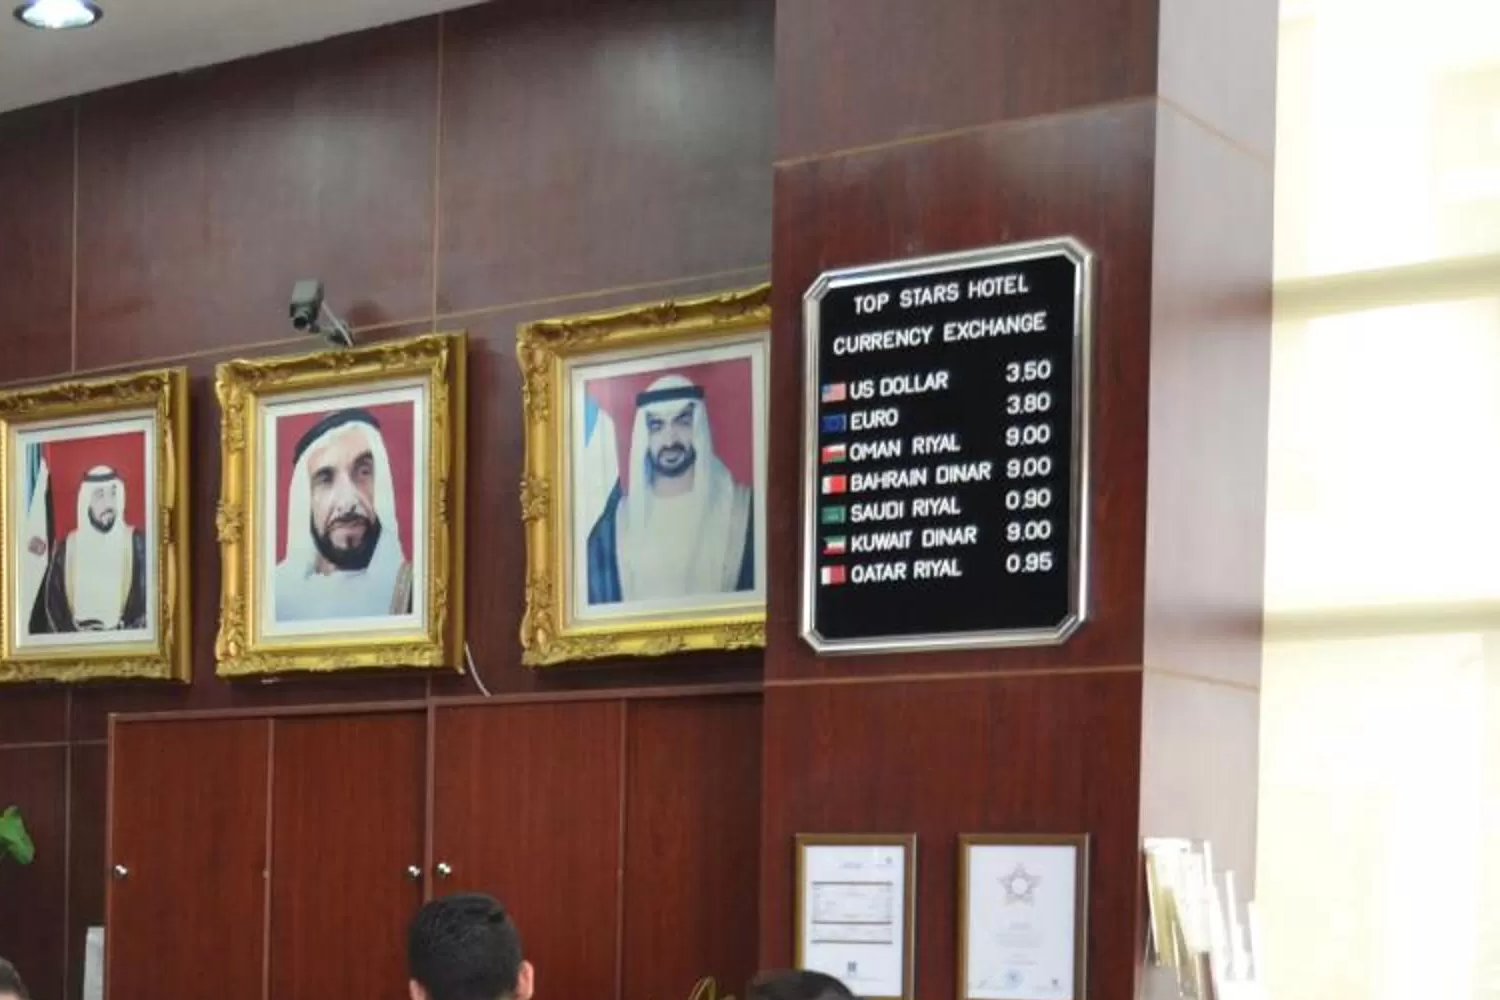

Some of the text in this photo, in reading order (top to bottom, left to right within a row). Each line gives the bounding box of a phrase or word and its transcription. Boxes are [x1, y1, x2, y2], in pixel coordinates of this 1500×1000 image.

[853, 273, 1029, 315] TOP STARS HOTEL
[832, 311, 1047, 356] CURRENCY EXCHANGE
[849, 359, 1052, 401] US DOLLAR 3.50
[850, 391, 1052, 432] EURO 3.80
[848, 423, 1051, 463] OMAN RIYAL 9.00
[849, 455, 1052, 494] BAHRAIN DINAR 9.00
[850, 500, 905, 524] SAUDI
[911, 495, 962, 518] RIYAL
[850, 519, 1052, 554] KUWAIT DINAR 9.00
[913, 557, 963, 580] RIYAL
[1005, 551, 1053, 575] 0.95
